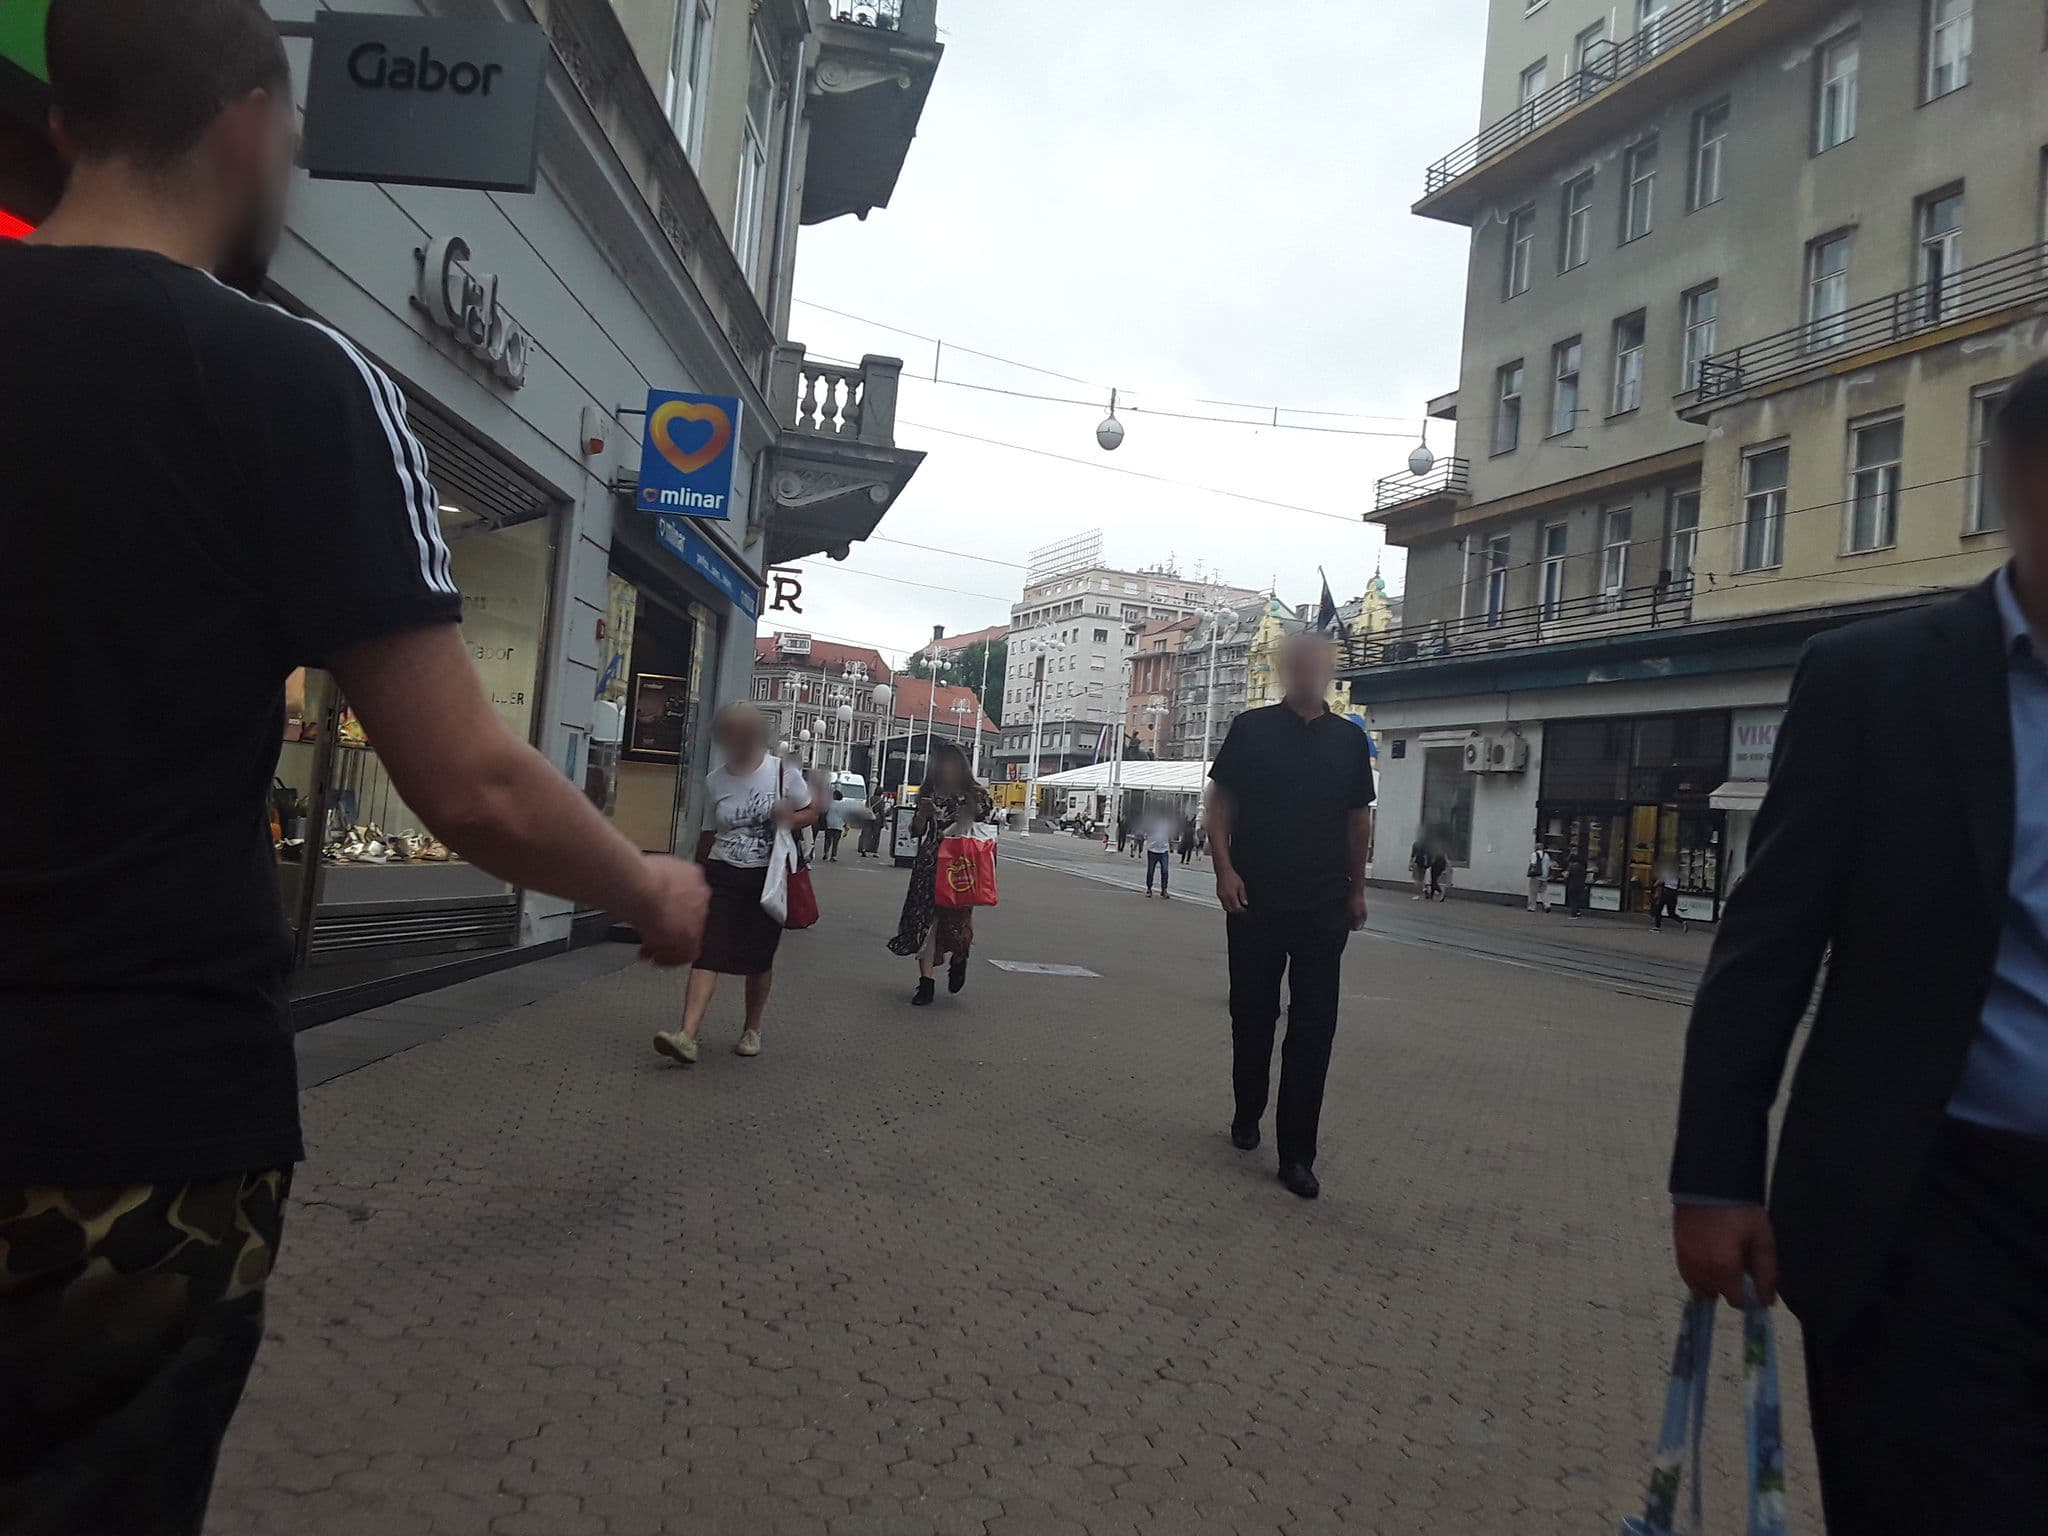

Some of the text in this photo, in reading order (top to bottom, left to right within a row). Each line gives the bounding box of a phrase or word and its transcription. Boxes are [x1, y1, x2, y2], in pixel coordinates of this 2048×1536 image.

[348, 42, 503, 97] Gabor
[660, 487, 725, 509] mlinar
[769, 574, 802, 614] R
[1737, 725, 1780, 747] VIK
